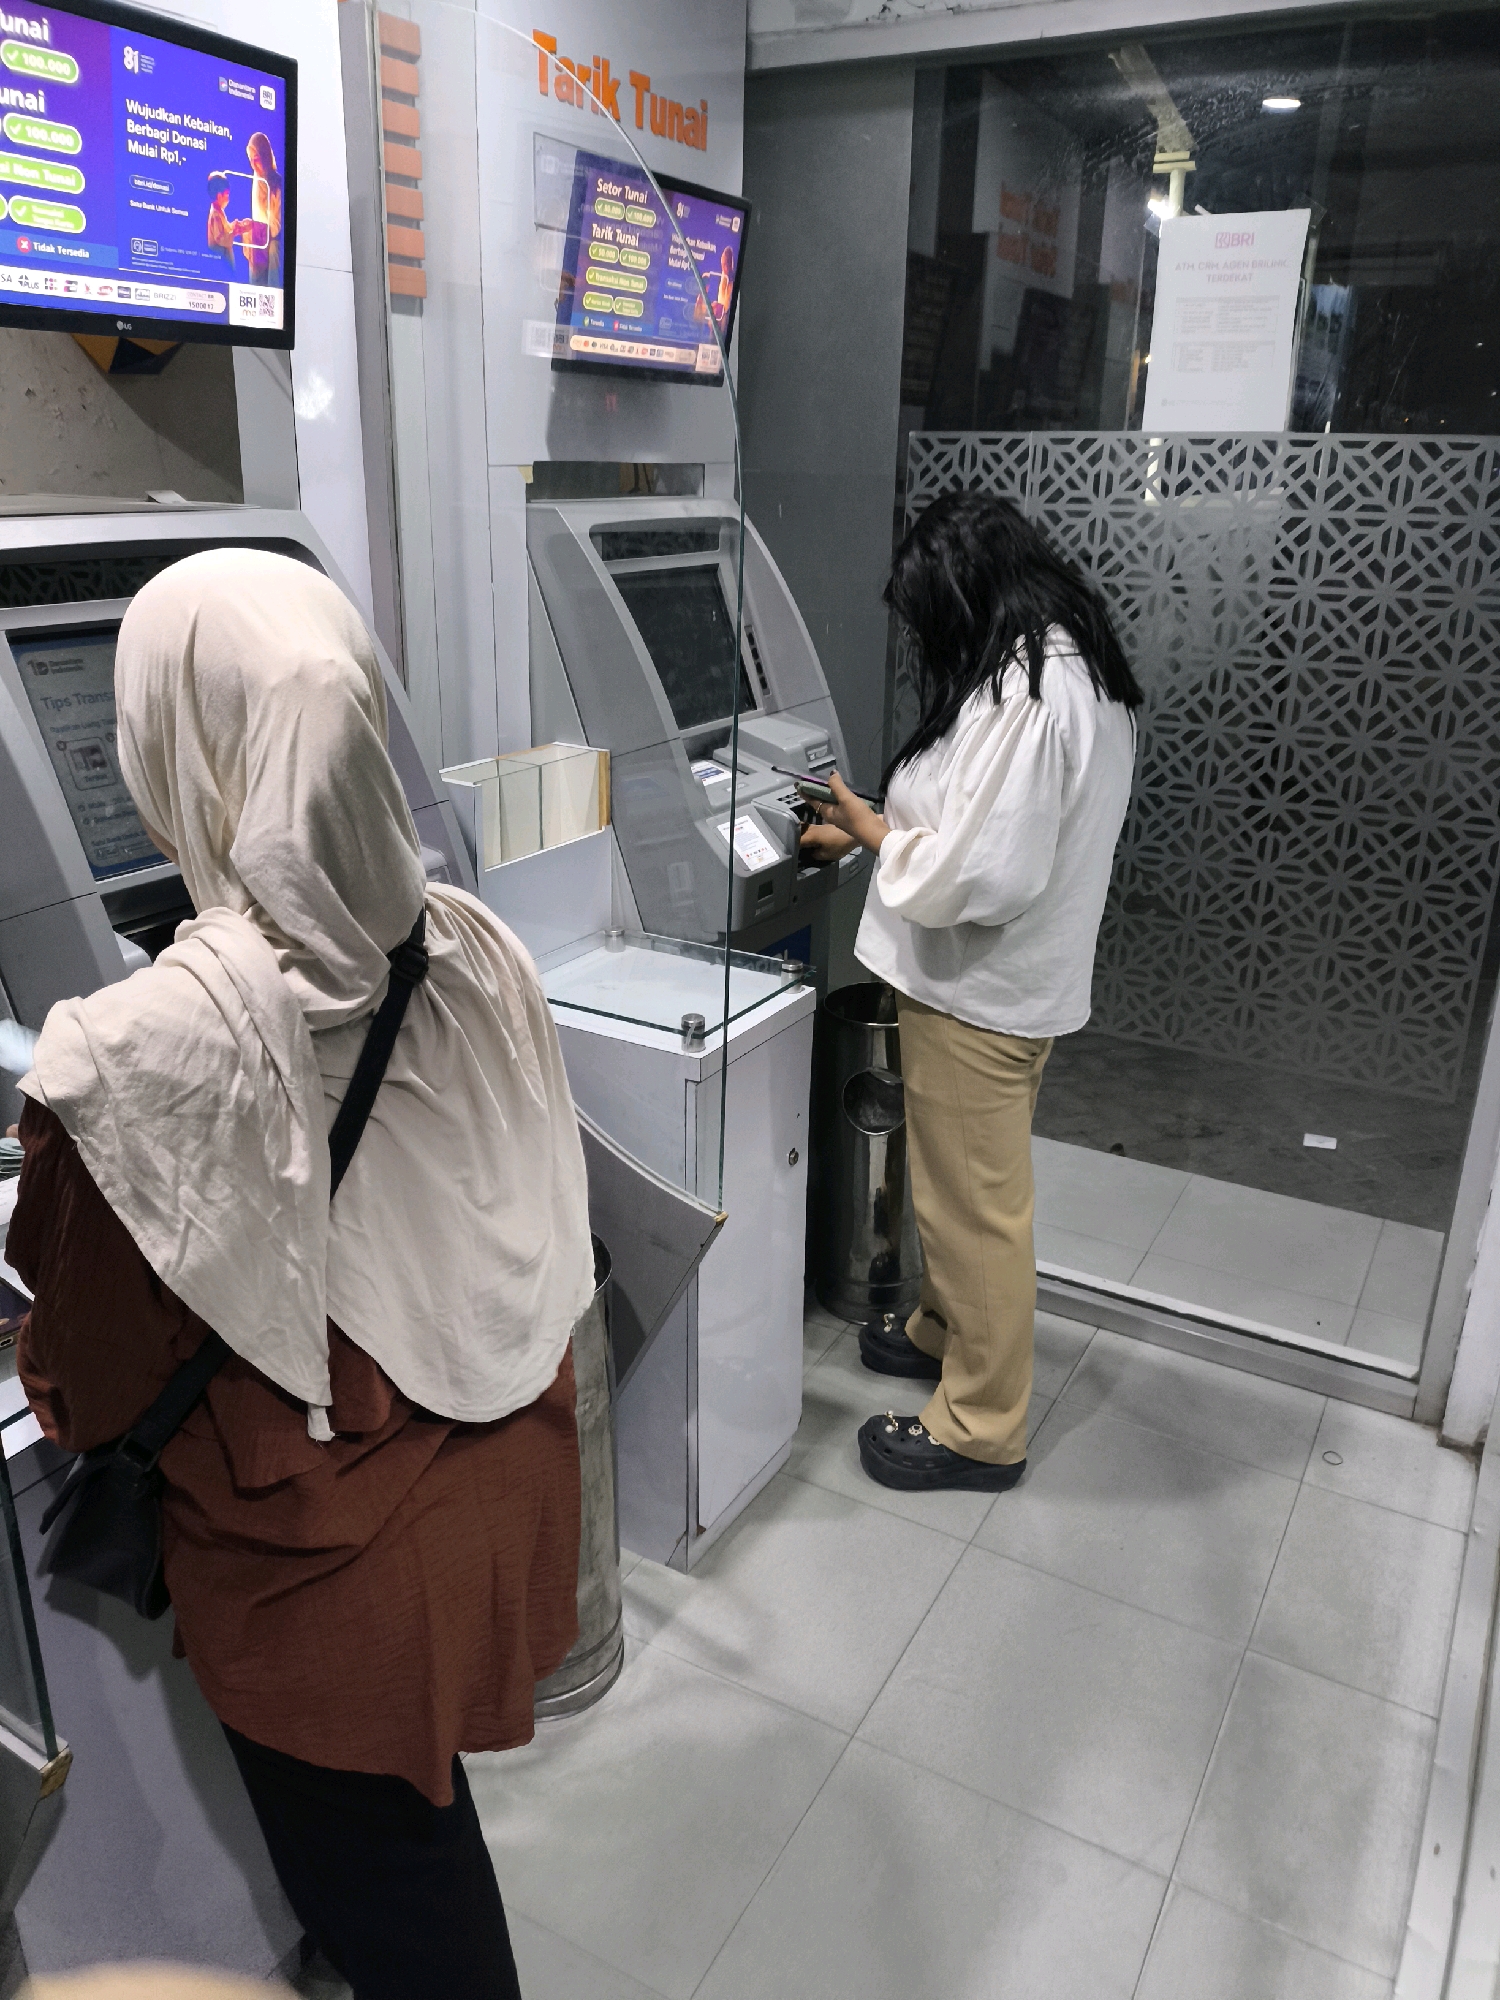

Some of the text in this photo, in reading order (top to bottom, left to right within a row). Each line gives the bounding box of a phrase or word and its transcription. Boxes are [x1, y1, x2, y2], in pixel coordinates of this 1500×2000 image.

[0, 8, 49, 41] unai
[22, 52, 71, 76] 100.000
[123, 46, 139, 75] 81
[0, 87, 45, 113] unai
[262, 89, 273, 101] BRI
[533, 29, 708, 151] Tarik Tunai
[125, 98, 233, 141] Wujudkan Kebaikan,
[25, 125, 75, 148] 100.000
[126, 118, 207, 151] Berbagi Donasi
[127, 138, 187, 166] Mulai Rp1,-
[597, 178, 648, 204] Setor Tunai
[592, 223, 614, 242] Tarik
[615, 228, 640, 248] Tunai
[1231, 232, 1255, 247] BRI
[33, 241, 90, 259] Tidak Tersedia
[0, 273, 12, 284] SA
[1206, 273, 1254, 283] TERDEKAT
[240, 295, 256, 309] BRI
[123, 322, 133, 331] LG
[40, 691, 115, 712] Tips Trans
